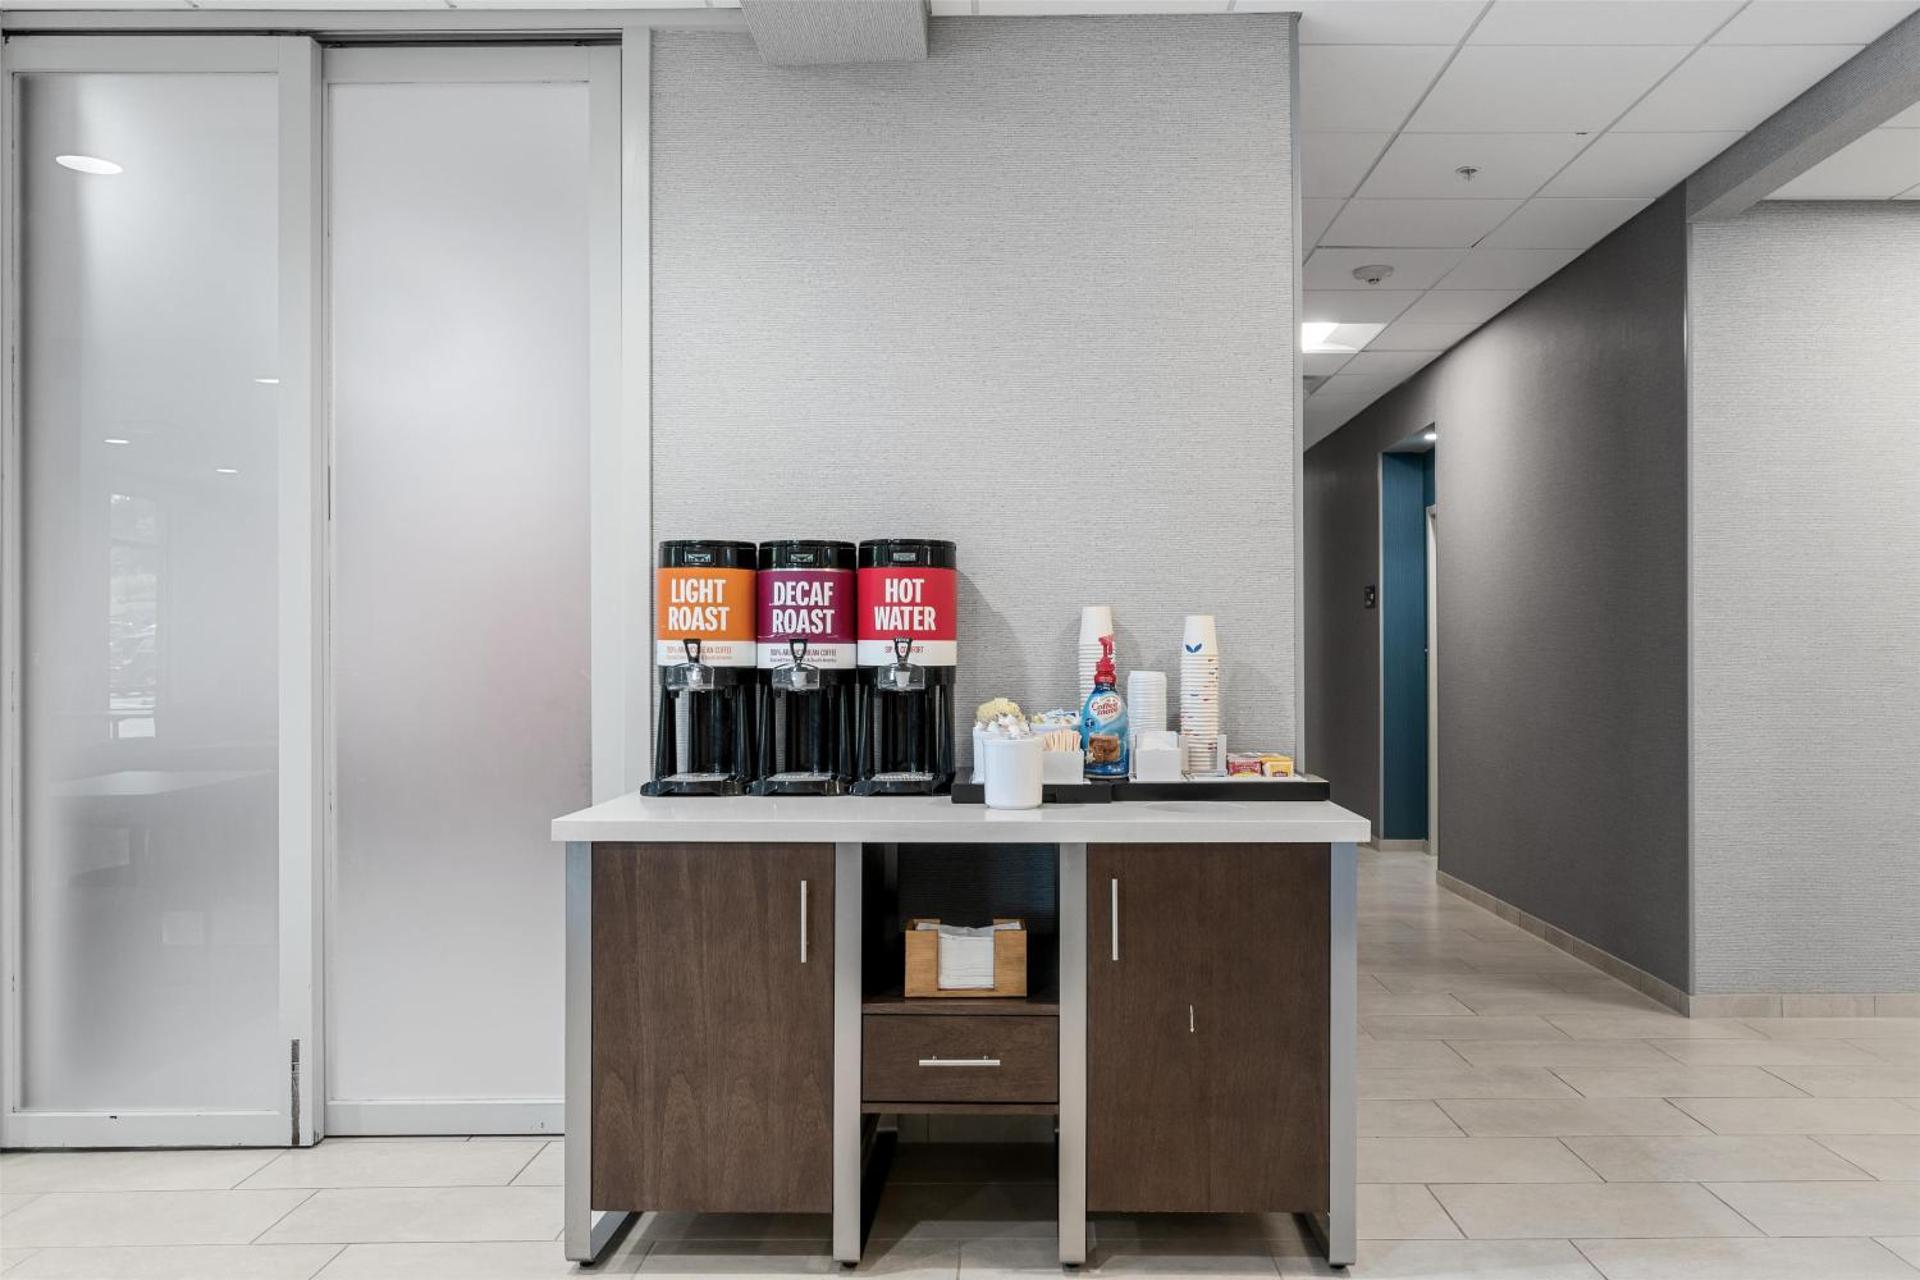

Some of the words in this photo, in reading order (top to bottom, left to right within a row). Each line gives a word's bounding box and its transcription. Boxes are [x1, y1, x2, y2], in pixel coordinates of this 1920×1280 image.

[670, 578, 727, 604] LIGHT
[773, 581, 834, 606] DECAF
[884, 578, 925, 604] HOT
[667, 606, 730, 632] ROAST
[772, 608, 835, 634] ROAST
[874, 606, 937, 631] WATER
